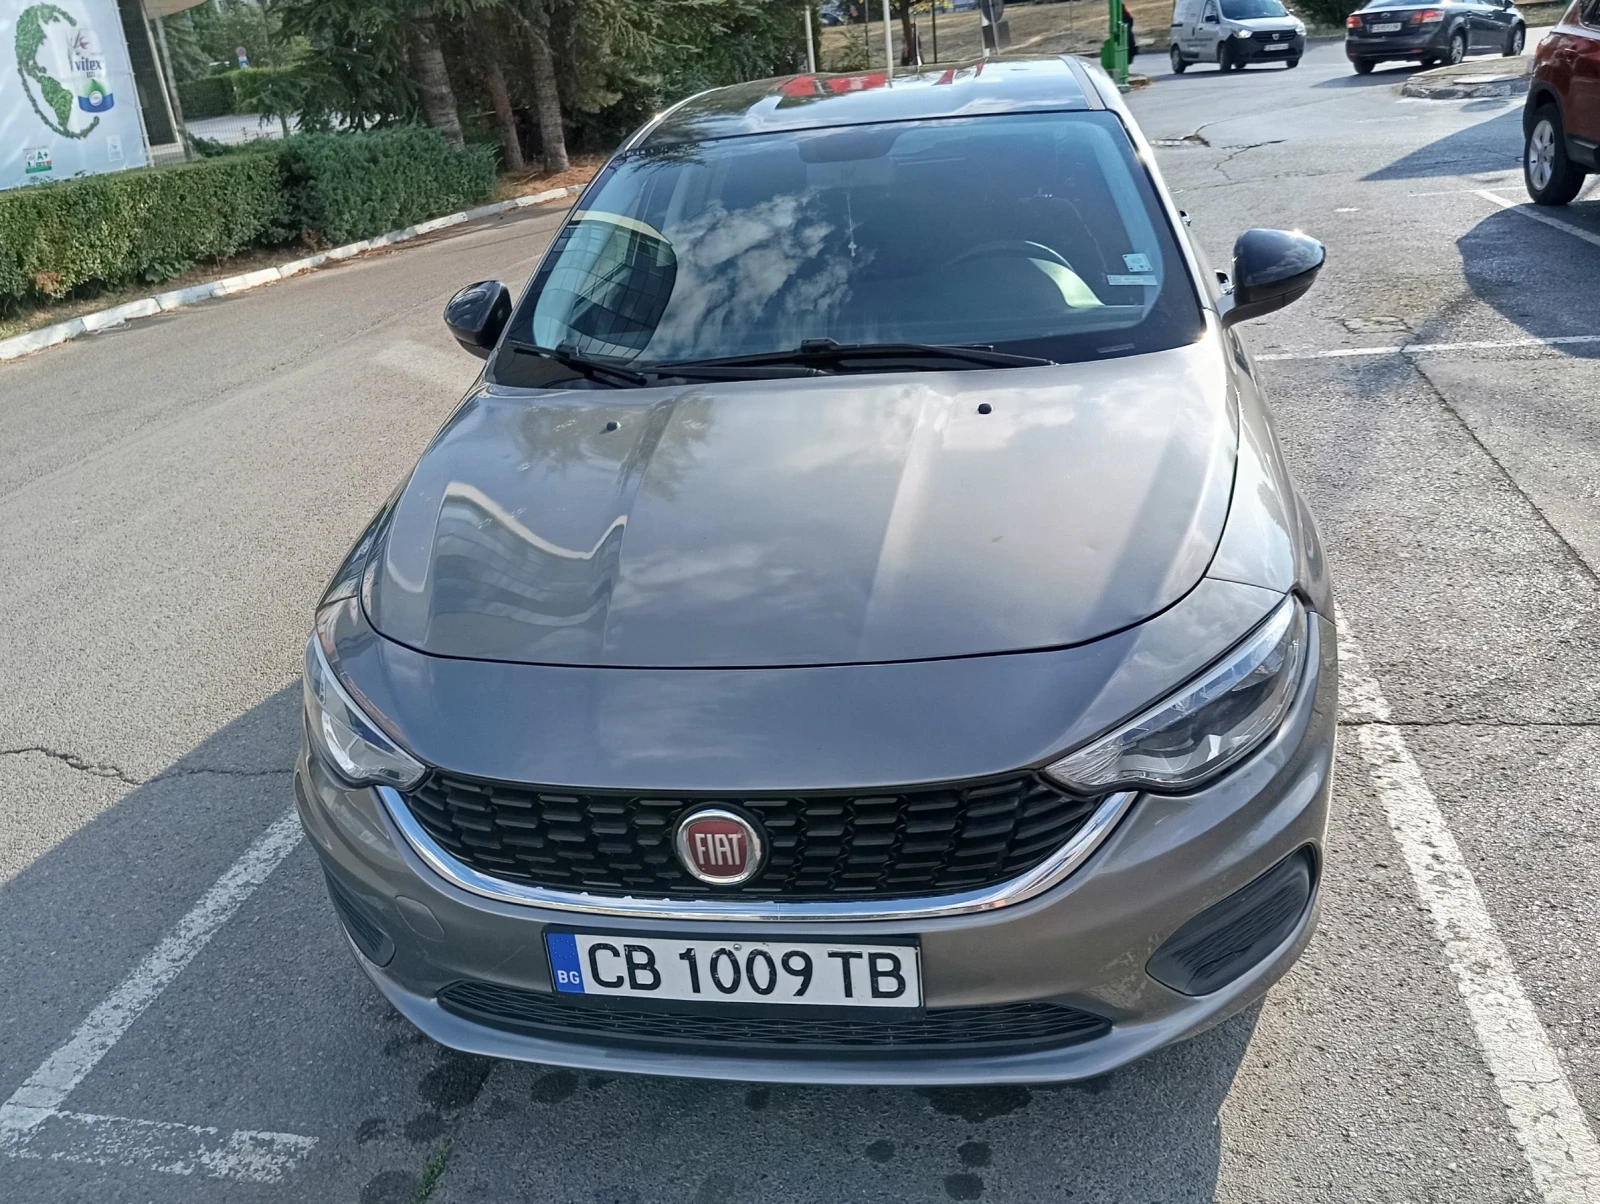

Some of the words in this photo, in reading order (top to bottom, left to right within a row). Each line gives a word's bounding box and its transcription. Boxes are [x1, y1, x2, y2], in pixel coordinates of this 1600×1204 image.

[75, 56, 102, 71] vitex
[695, 833, 742, 866] FIAT
[558, 970, 580, 985] BG
[588, 943, 662, 991] CB
[679, 947, 813, 997] 1009
[827, 950, 906, 999] TB
